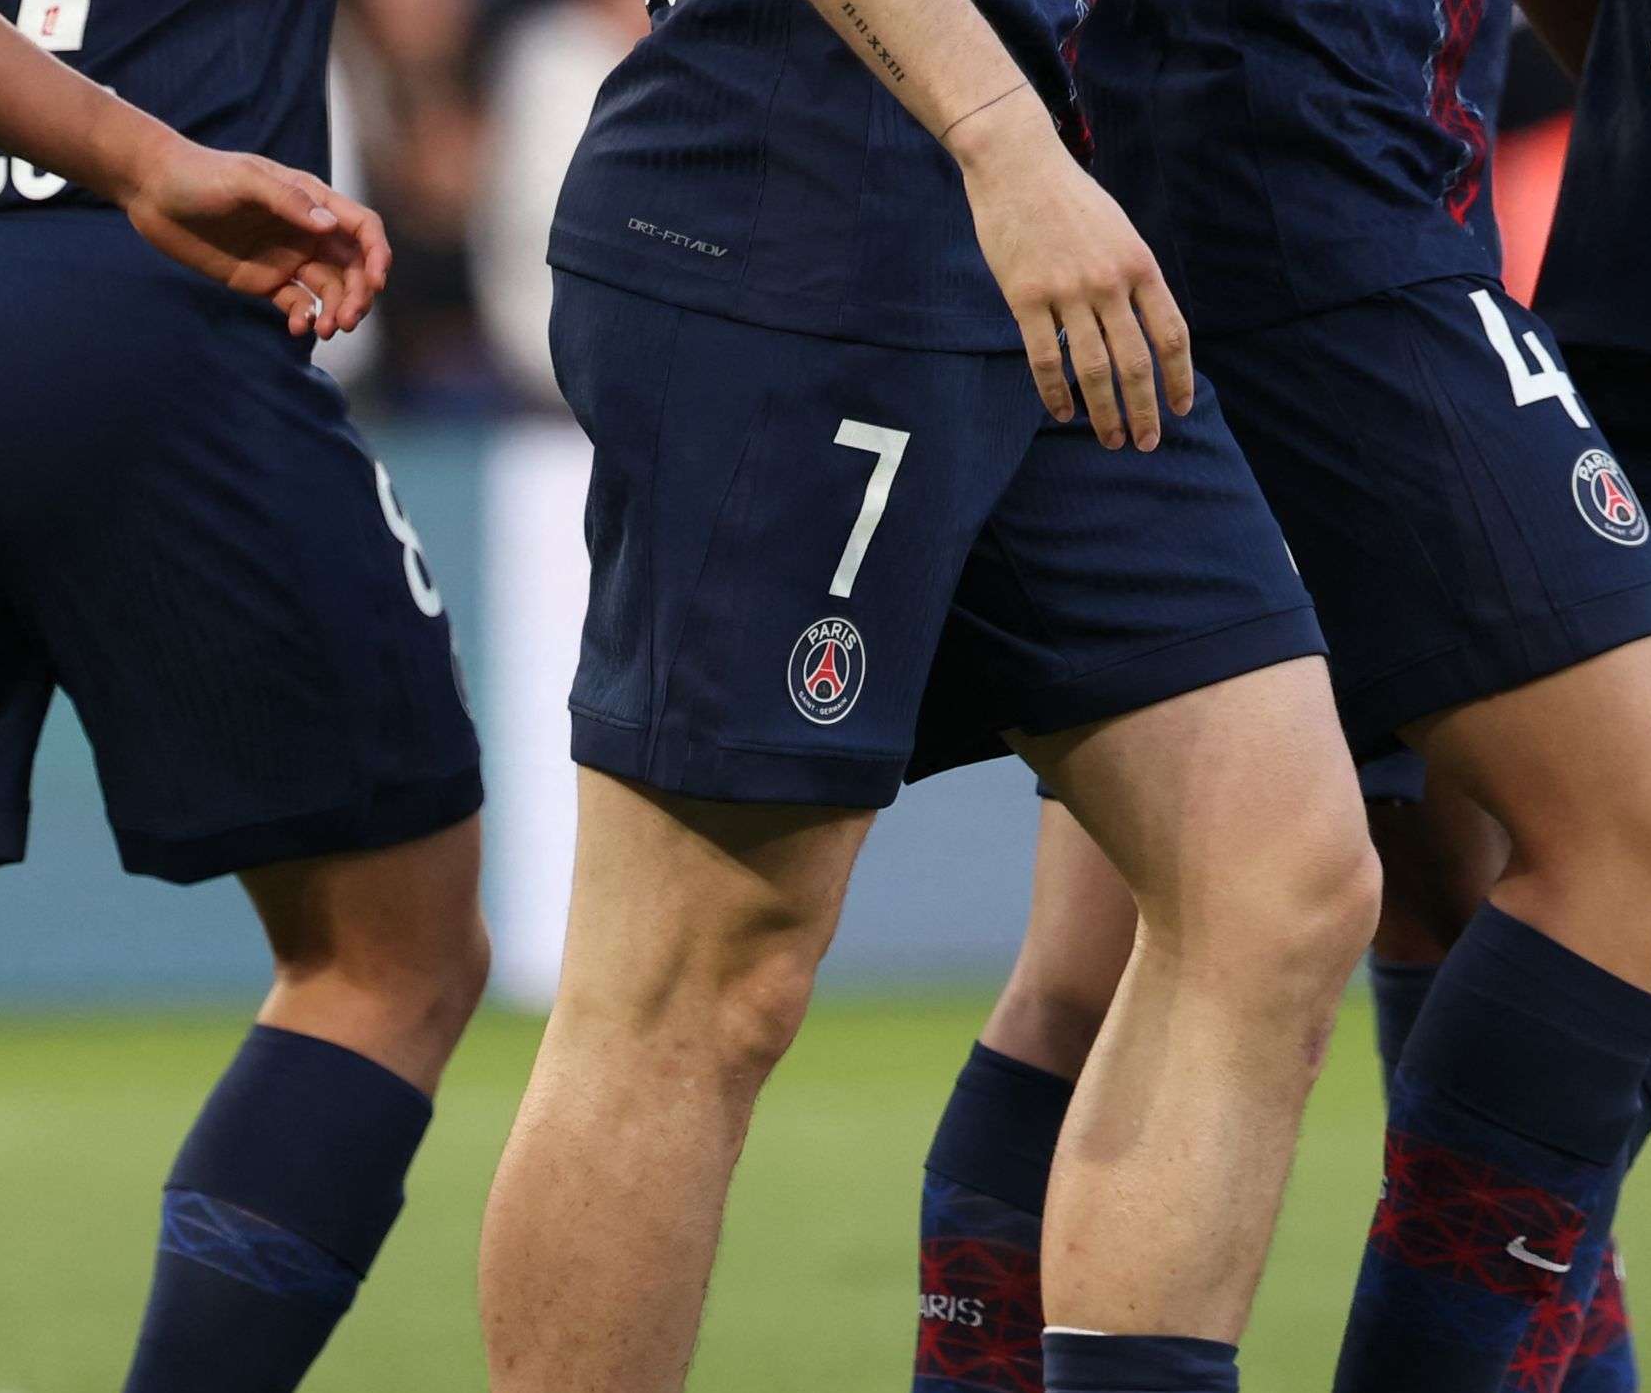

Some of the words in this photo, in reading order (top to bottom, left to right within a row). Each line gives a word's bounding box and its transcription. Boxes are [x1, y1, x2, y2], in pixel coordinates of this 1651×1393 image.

[1468, 289, 1591, 429] 4
[829, 418, 911, 599] 7
[808, 622, 857, 650] PARIS
